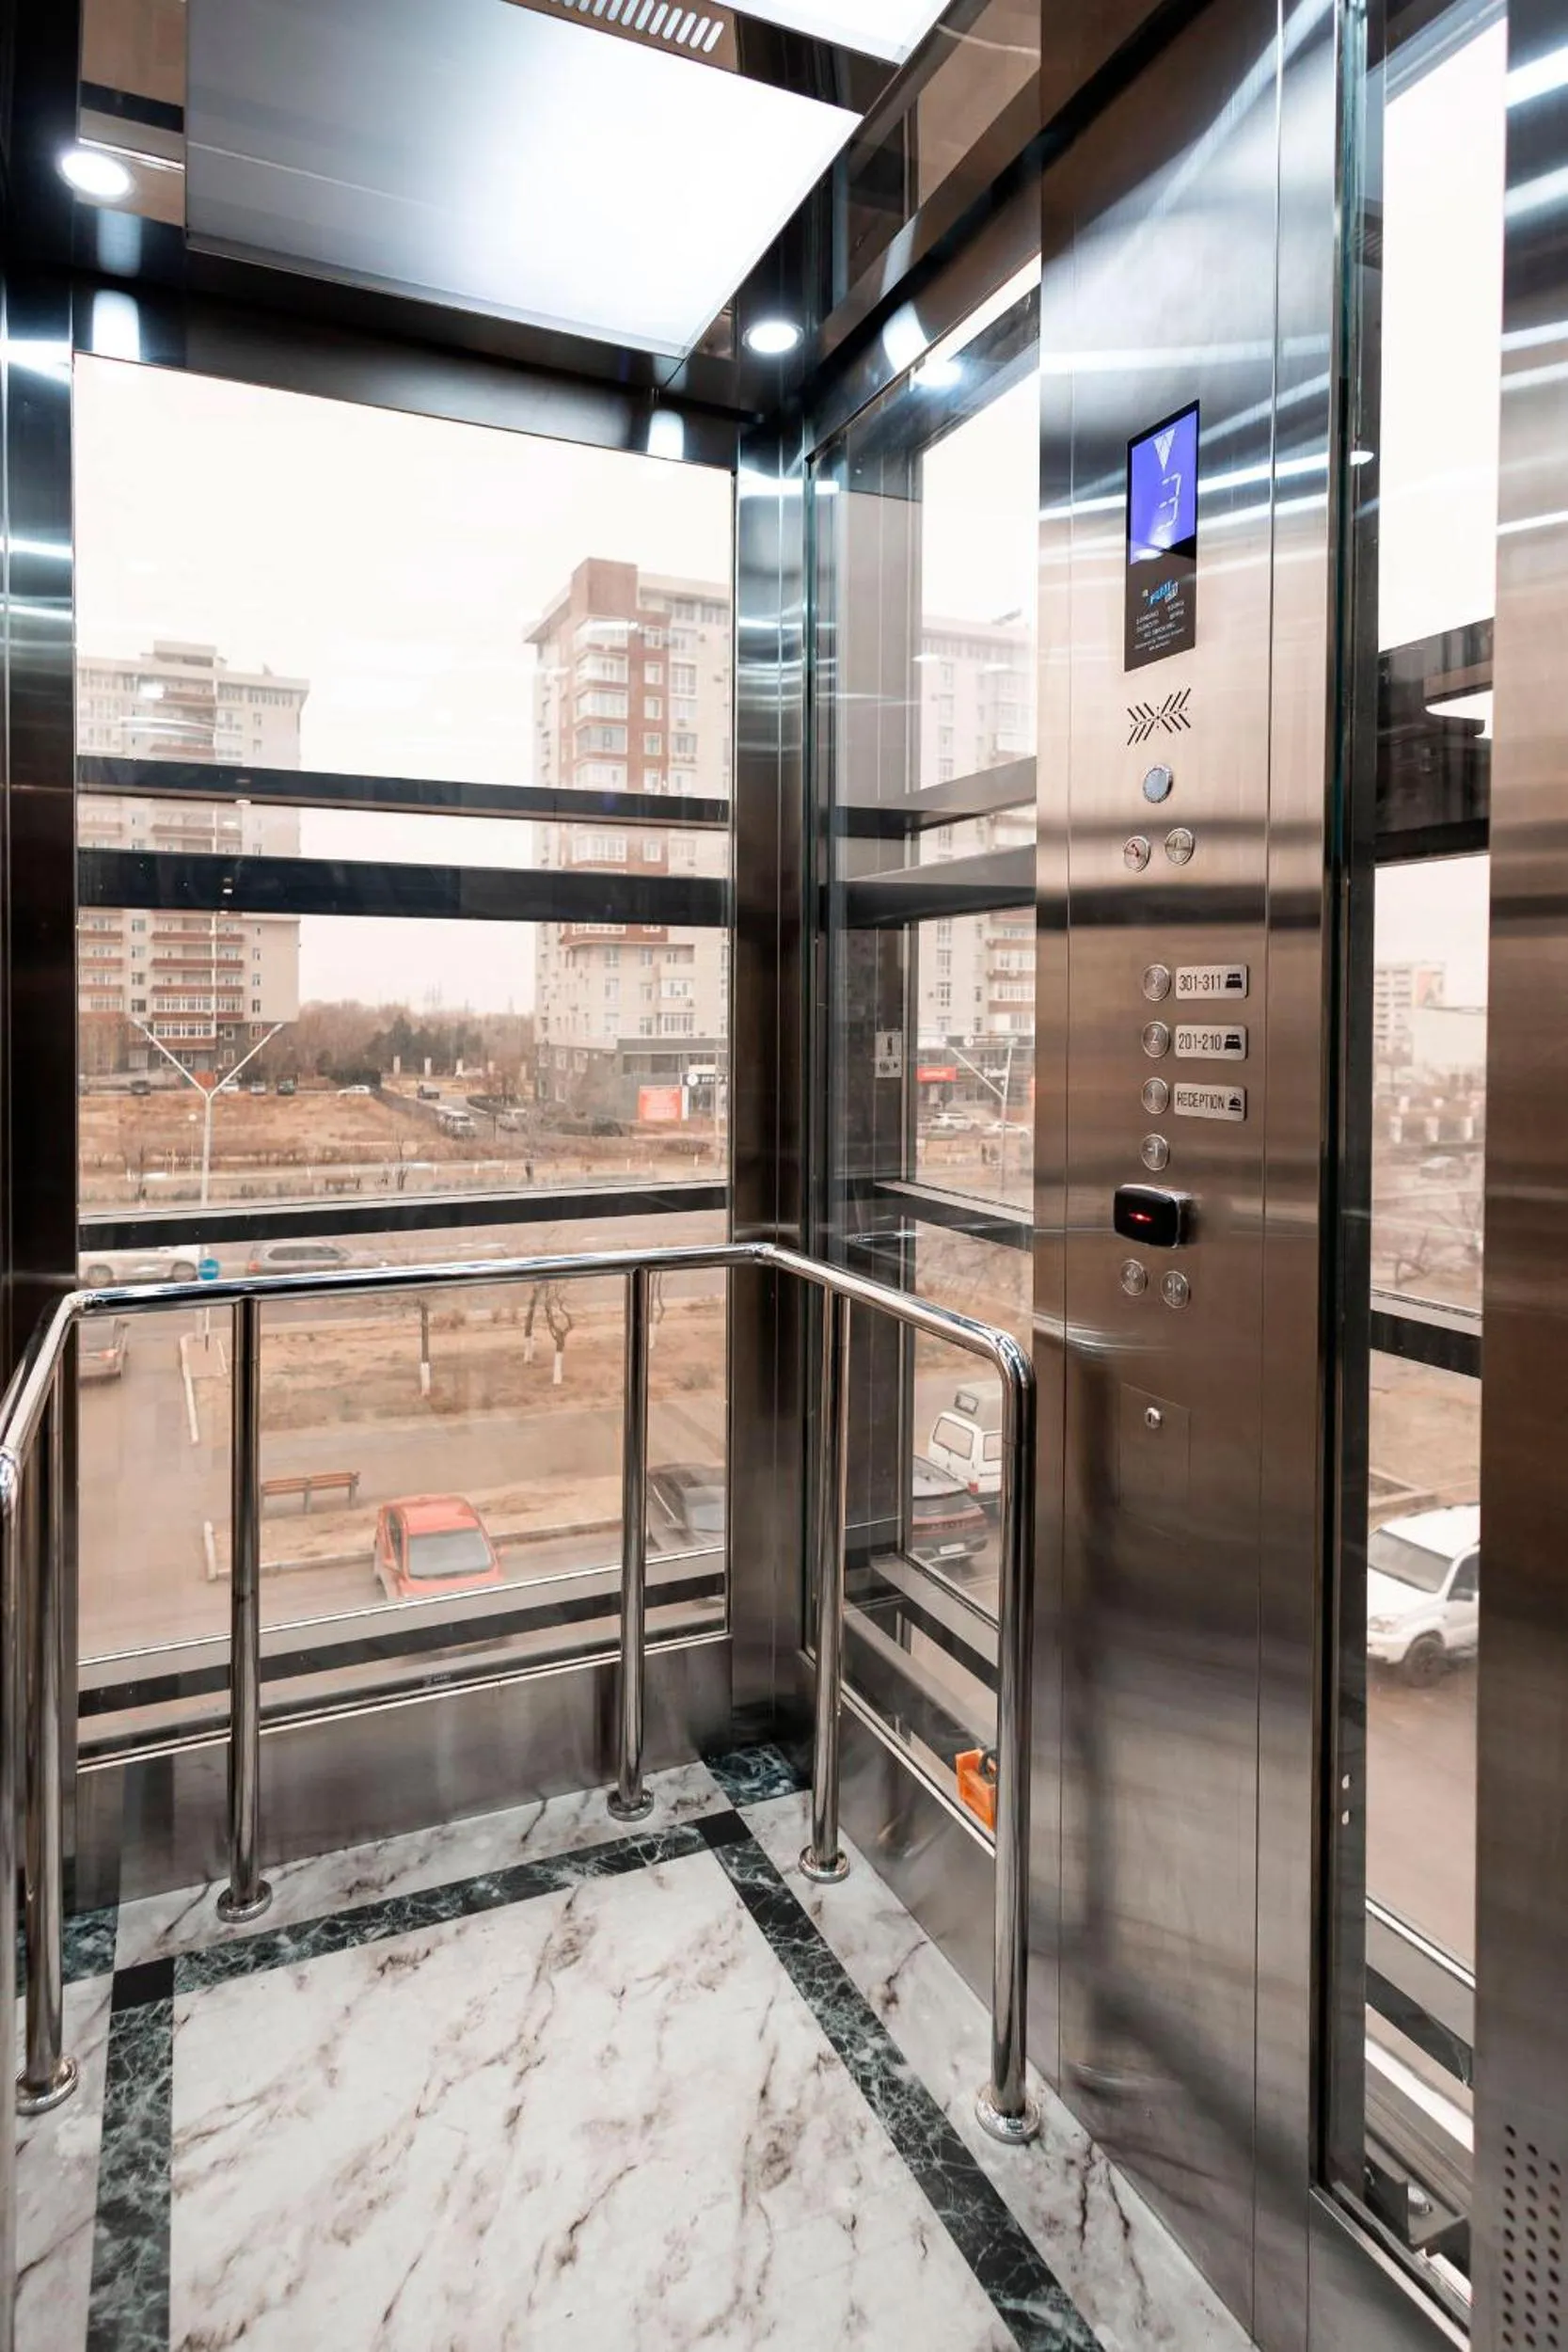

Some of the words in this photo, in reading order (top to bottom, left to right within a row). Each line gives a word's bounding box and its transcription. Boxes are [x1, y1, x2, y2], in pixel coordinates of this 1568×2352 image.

[1158, 472, 1181, 532] 3
[1179, 974, 1221, 992] 301-311
[1179, 1033, 1222, 1051] 201-210
[1177, 1091, 1225, 1110] RECEPTION
